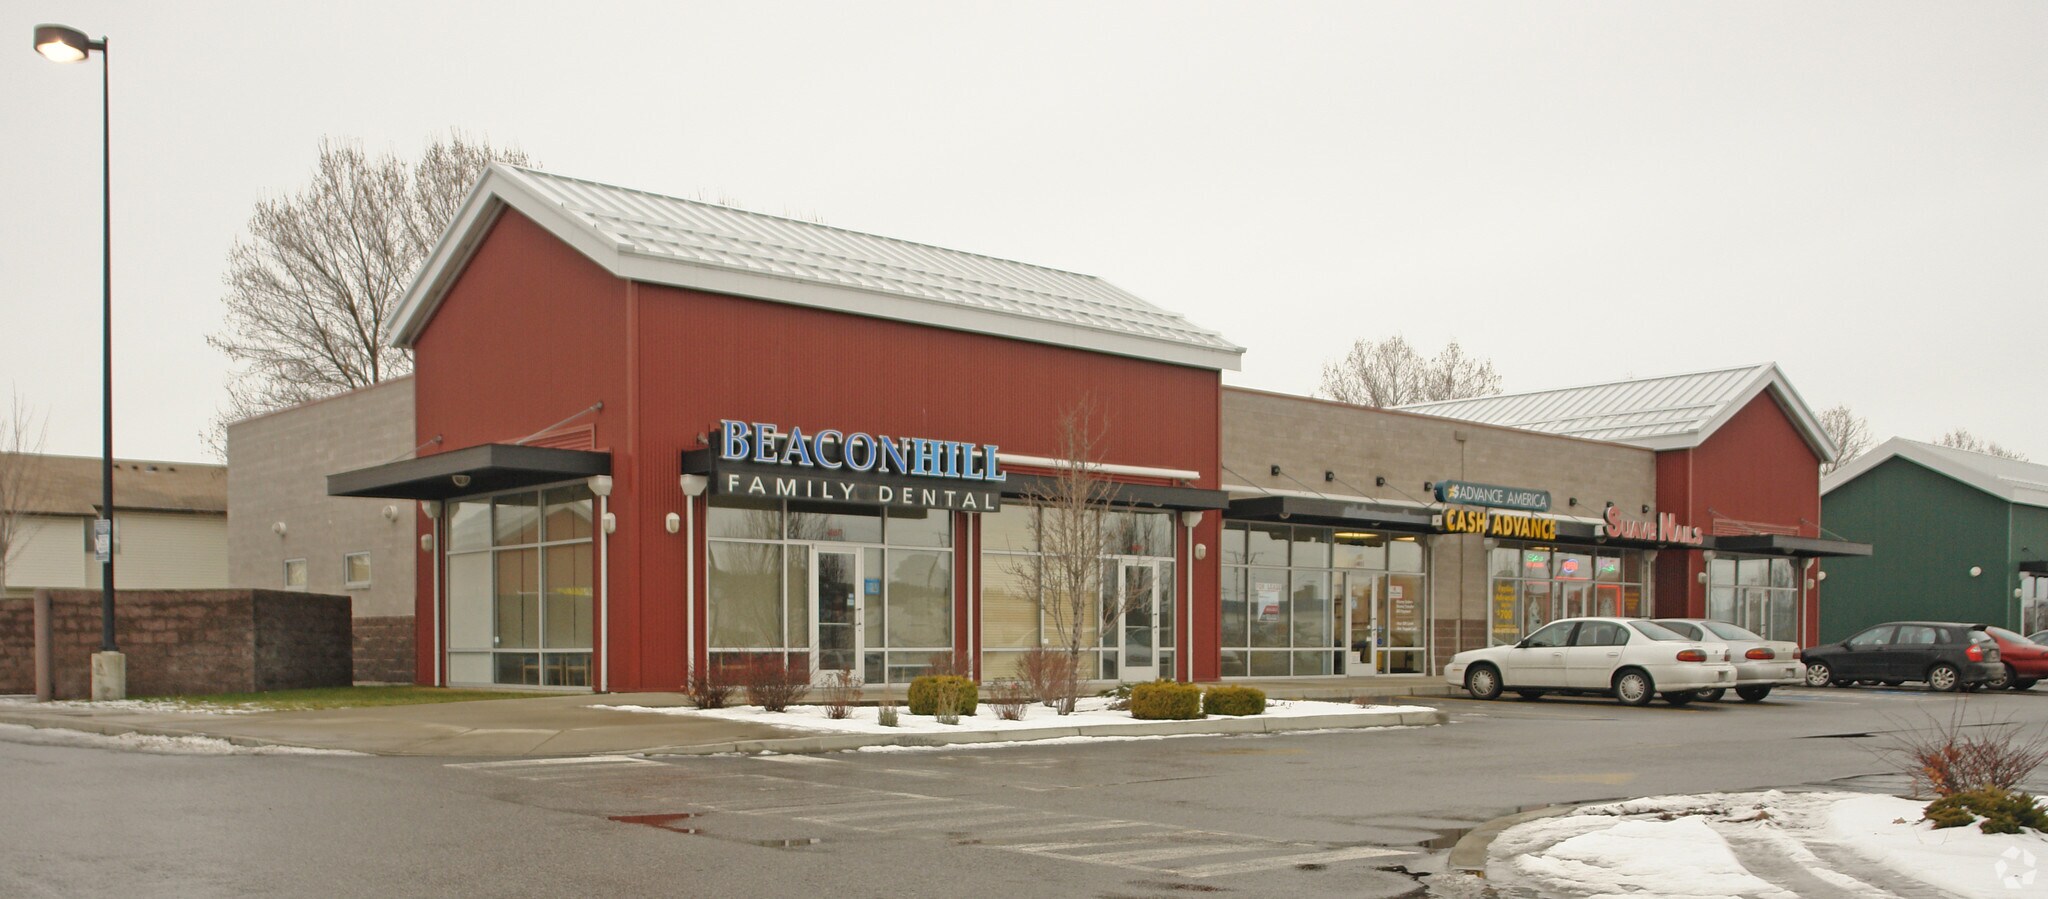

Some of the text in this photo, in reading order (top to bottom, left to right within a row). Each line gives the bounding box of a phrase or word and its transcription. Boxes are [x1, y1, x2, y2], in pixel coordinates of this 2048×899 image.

[720, 419, 1007, 481] BEACONHILL
[728, 474, 995, 510] FAMILY DENTAL
[1459, 486, 1547, 507] ADVANCE AMERICA
[1447, 508, 1556, 540] CASH ADVANCE
